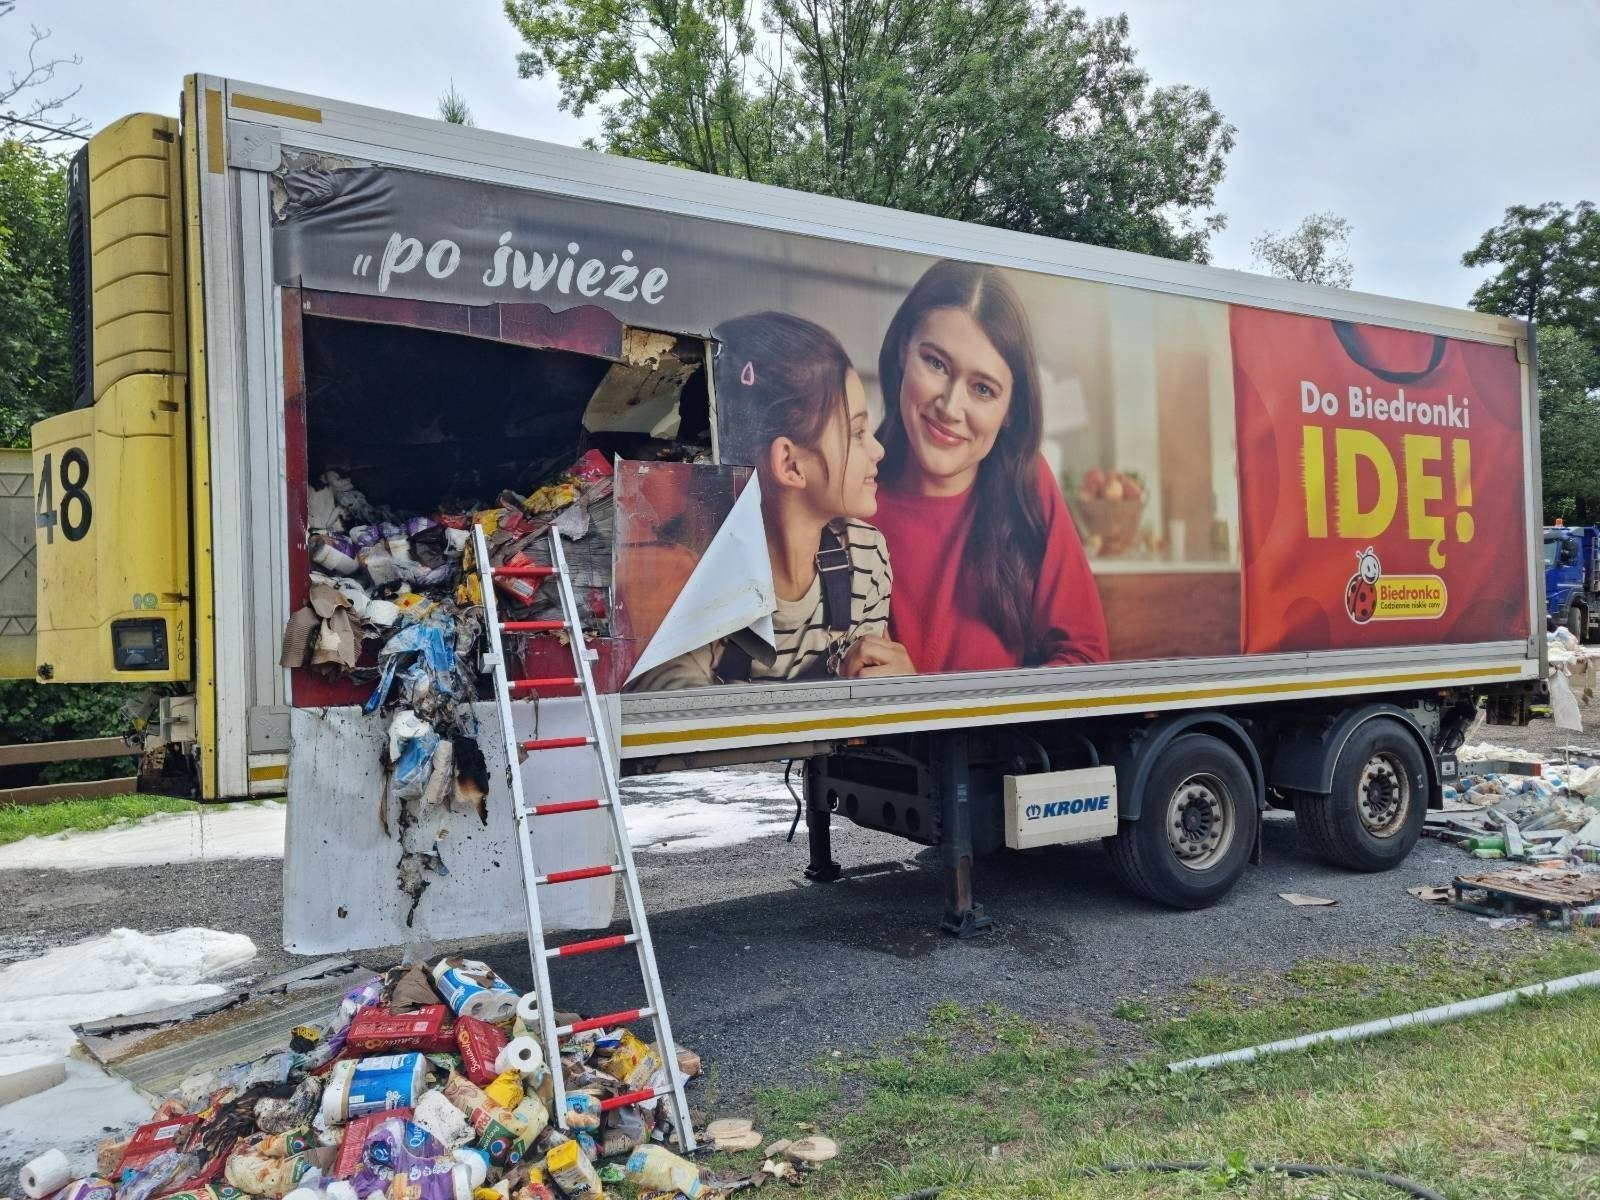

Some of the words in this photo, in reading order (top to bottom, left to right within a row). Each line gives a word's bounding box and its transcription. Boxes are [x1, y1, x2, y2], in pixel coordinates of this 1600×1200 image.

[483, 231, 669, 304] świeże
[1301, 380, 1339, 416] Do
[1349, 386, 1470, 429] Biedronki
[36, 447, 92, 544] 48
[1300, 425, 1475, 569] IDĘ!
[1380, 584, 1440, 600] Biedronka
[1380, 601, 1410, 610] Codziennie
[1412, 601, 1427, 609] niskie
[1428, 601, 1440, 609] ceny
[1042, 795, 1110, 818] KRONE
